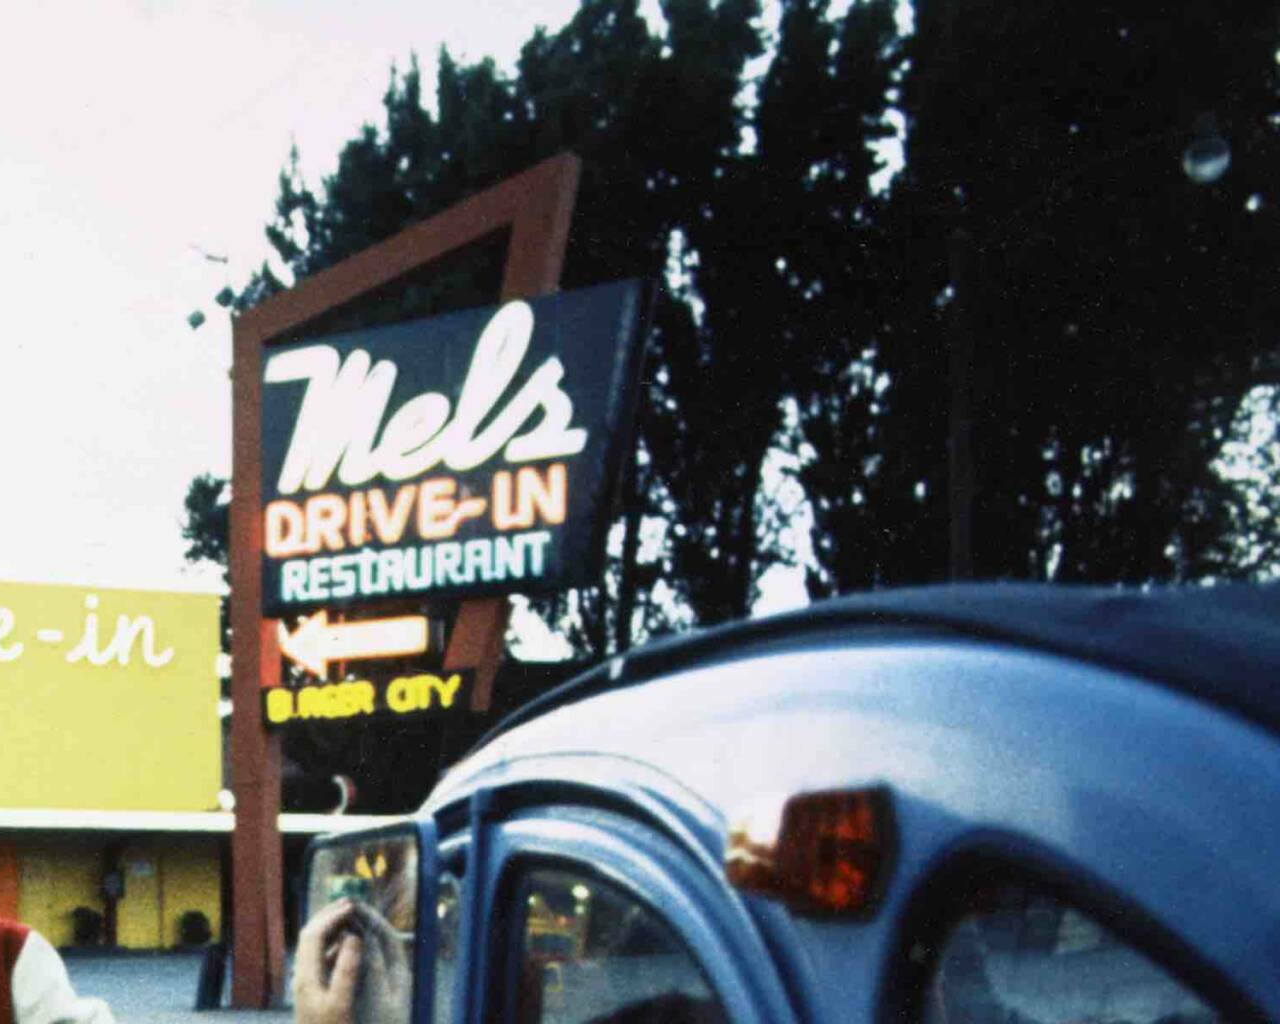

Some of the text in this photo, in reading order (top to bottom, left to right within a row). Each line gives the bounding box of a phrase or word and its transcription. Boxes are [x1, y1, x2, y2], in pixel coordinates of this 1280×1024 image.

[264, 300, 588, 494] Mels
[265, 463, 567, 558] DRIVE-IN
[281, 530, 551, 602] RESTAURANT
[386, 674, 462, 713] CITY
